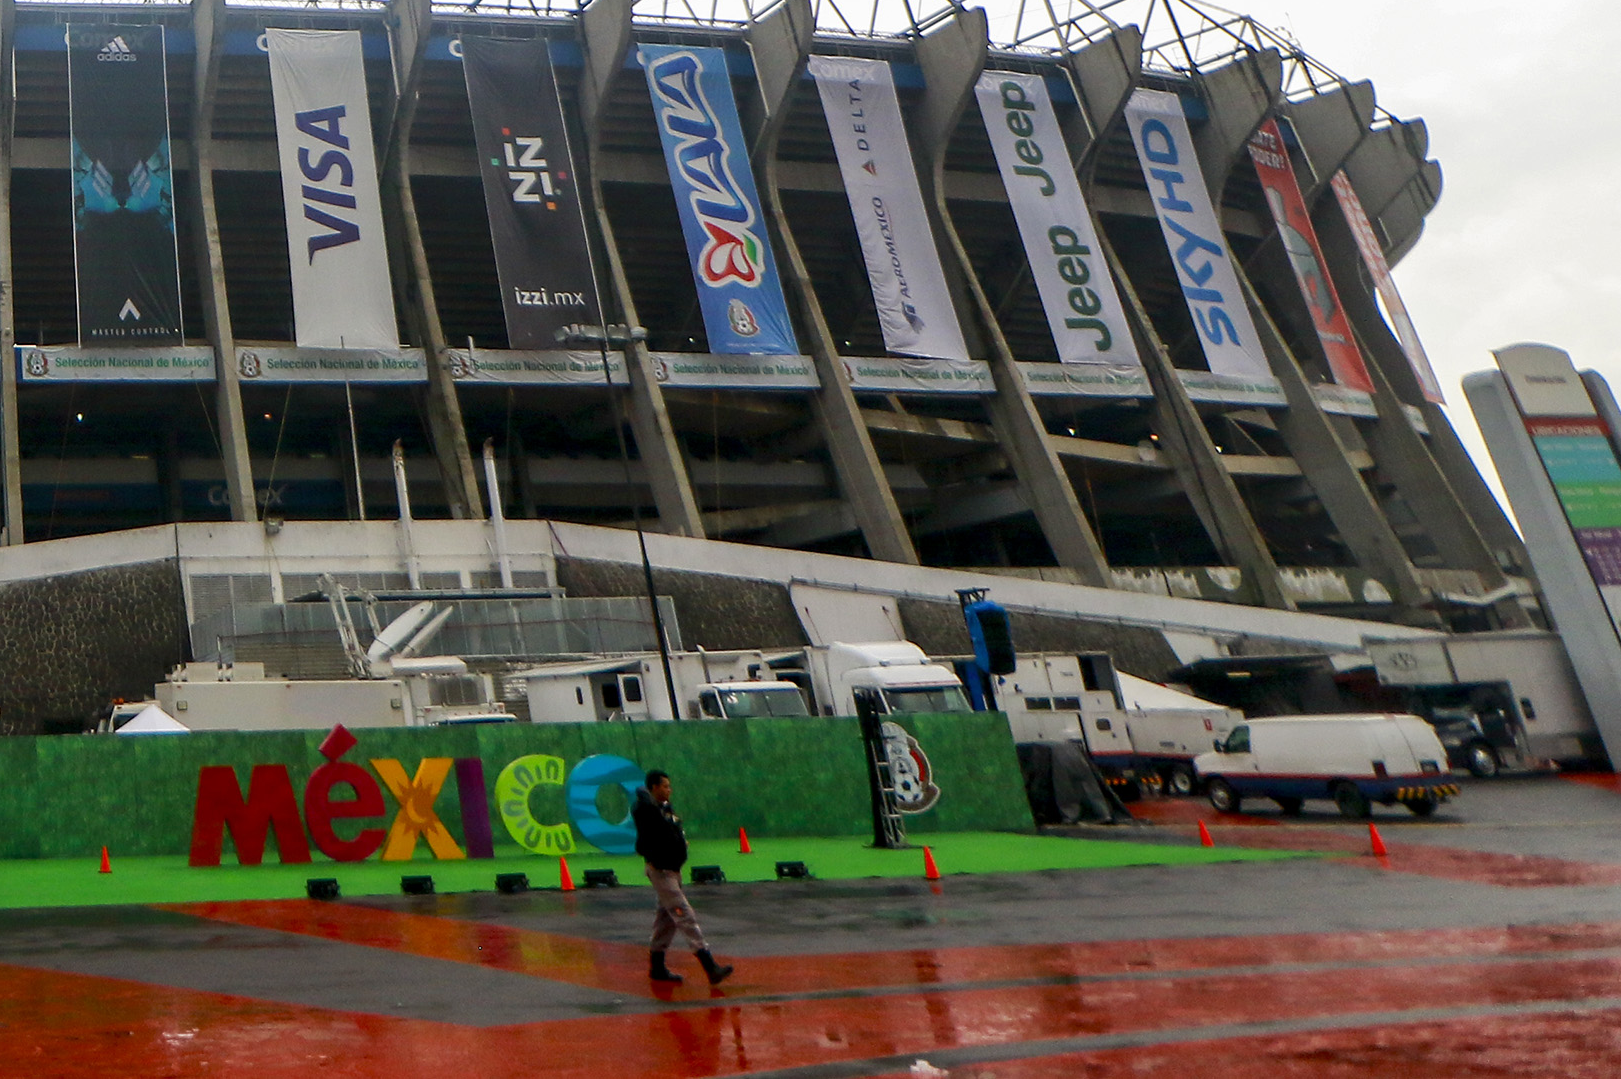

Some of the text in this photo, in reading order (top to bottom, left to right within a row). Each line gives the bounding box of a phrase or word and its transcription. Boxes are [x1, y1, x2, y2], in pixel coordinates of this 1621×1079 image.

[96, 52, 137, 62] adidas
[849, 79, 870, 152] DELTA
[1000, 81, 1056, 197] Jeep
[295, 105, 361, 267] VISA
[513, 287, 586, 306] izzi.mx
[1047, 225, 1113, 352] Jeep
[55, 357, 209, 368] Selección Nacional de México
[267, 357, 419, 370] Selección Nacional de México
